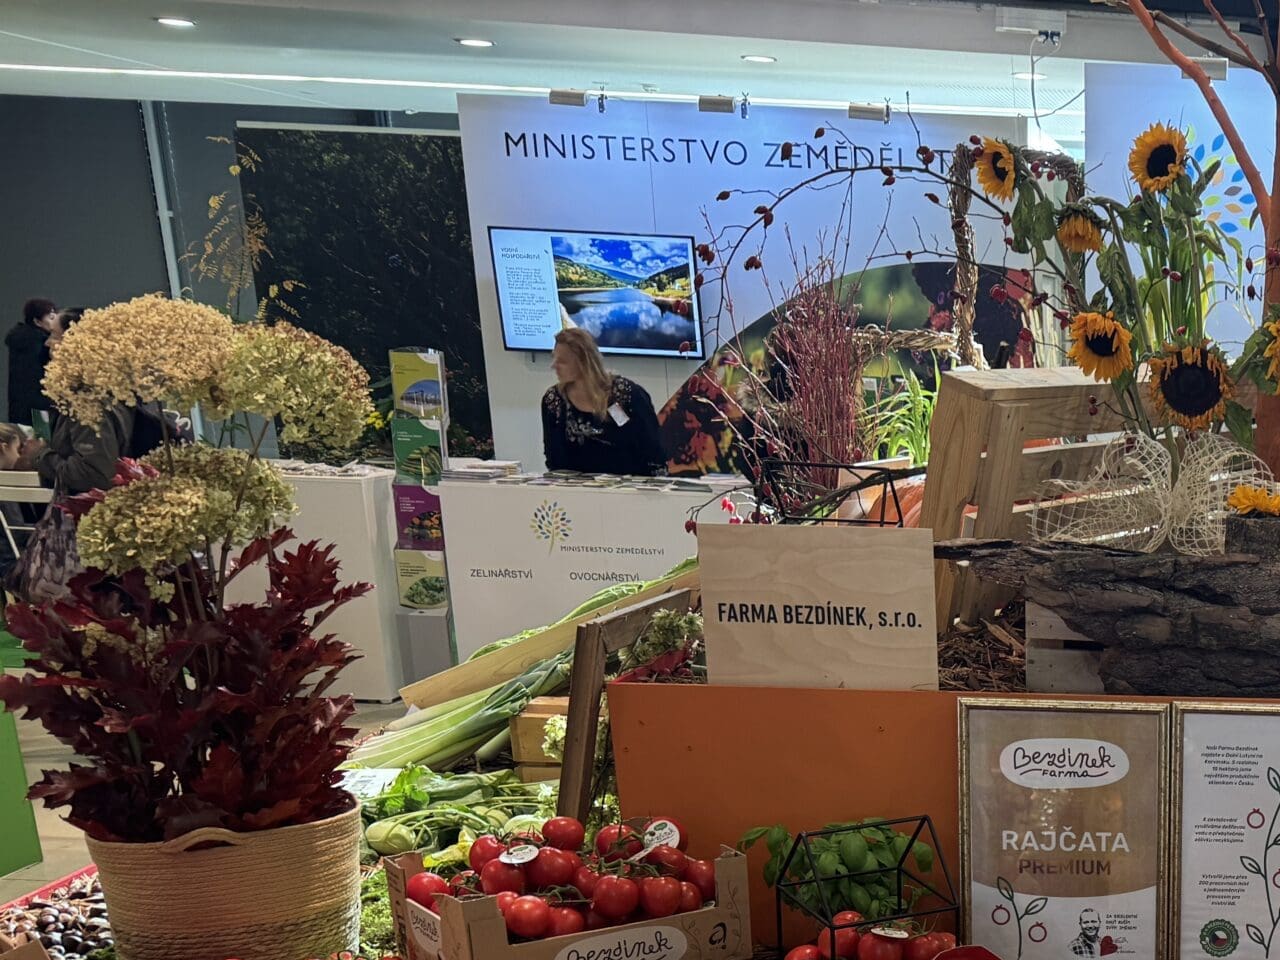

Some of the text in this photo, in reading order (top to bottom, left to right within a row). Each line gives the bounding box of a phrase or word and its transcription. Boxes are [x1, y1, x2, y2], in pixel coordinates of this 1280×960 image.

[503, 131, 749, 167] MINISTERSTVO
[560, 545, 665, 556] MINISTERSTVO ZEMĚDĚLSTVÍ
[470, 568, 533, 579] ZELINÁŘSTVÍ
[569, 571, 640, 583] OVOCNÁŘSTVÍ
[717, 601, 922, 630] FARMA BEZDÍNEK, s.r.o.
[1002, 825, 1130, 853] RAJČATA
[1018, 858, 1111, 876] PREMIUM
